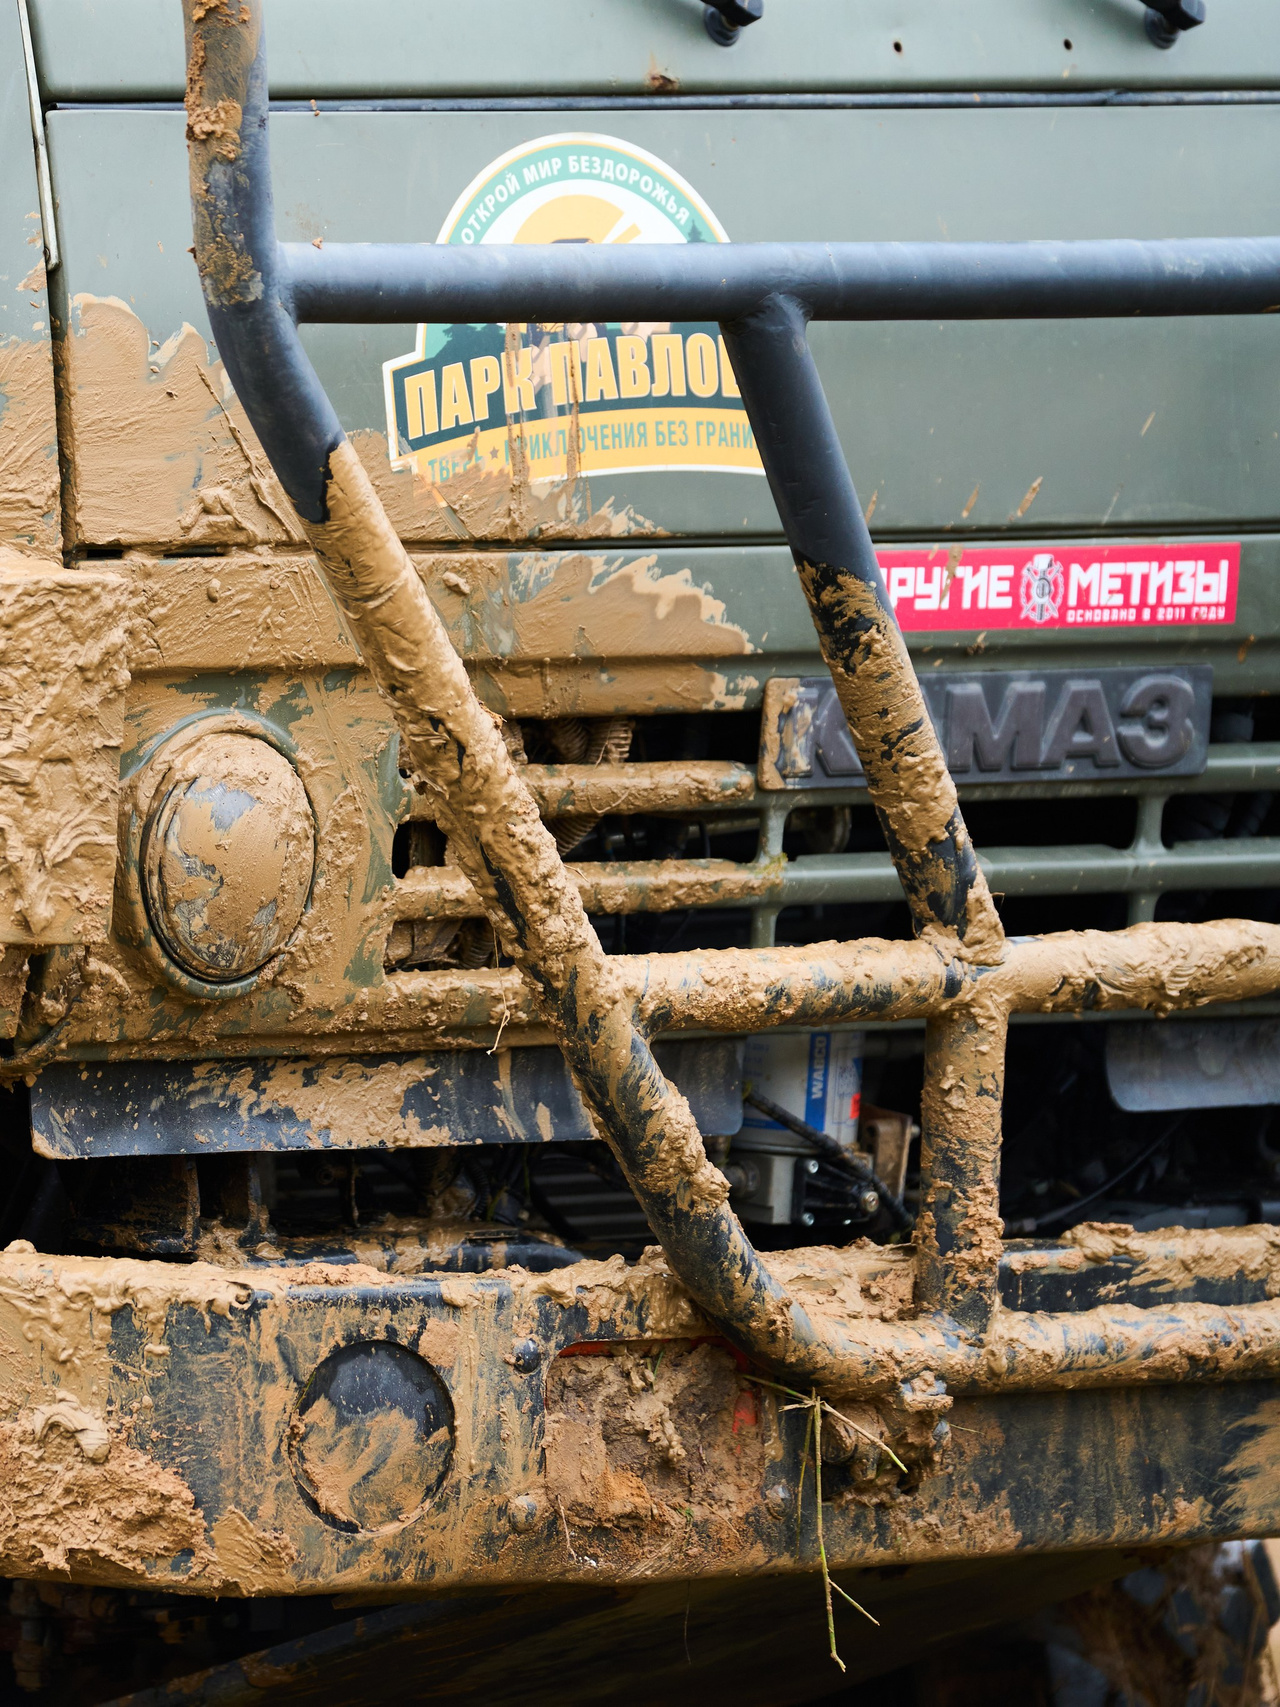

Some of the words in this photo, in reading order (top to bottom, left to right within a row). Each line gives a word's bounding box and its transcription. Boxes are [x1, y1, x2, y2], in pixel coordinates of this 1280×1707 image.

[461, 171, 521, 244] ОТКРОЙ
[523, 157, 562, 185] МИР
[568, 155, 690, 225] БЕЗДОРОЖЬЯ
[404, 347, 537, 440] ПАРК
[656, 420, 689, 447] БЕЗ
[695, 420, 758, 449] ГРАНИ
[882, 565, 1014, 611] РУГИЕ
[1067, 560, 1228, 606] МЕТИЗЫ
[1066, 608, 1136, 623] ОСНОВАНО
[1142, 607, 1151, 622] В
[1157, 606, 1186, 620] 2011
[1191, 605, 1226, 619] ГОДУ
[783, 673, 1195, 778] КМАЗ
[812, 1036, 826, 1099] WABCO
